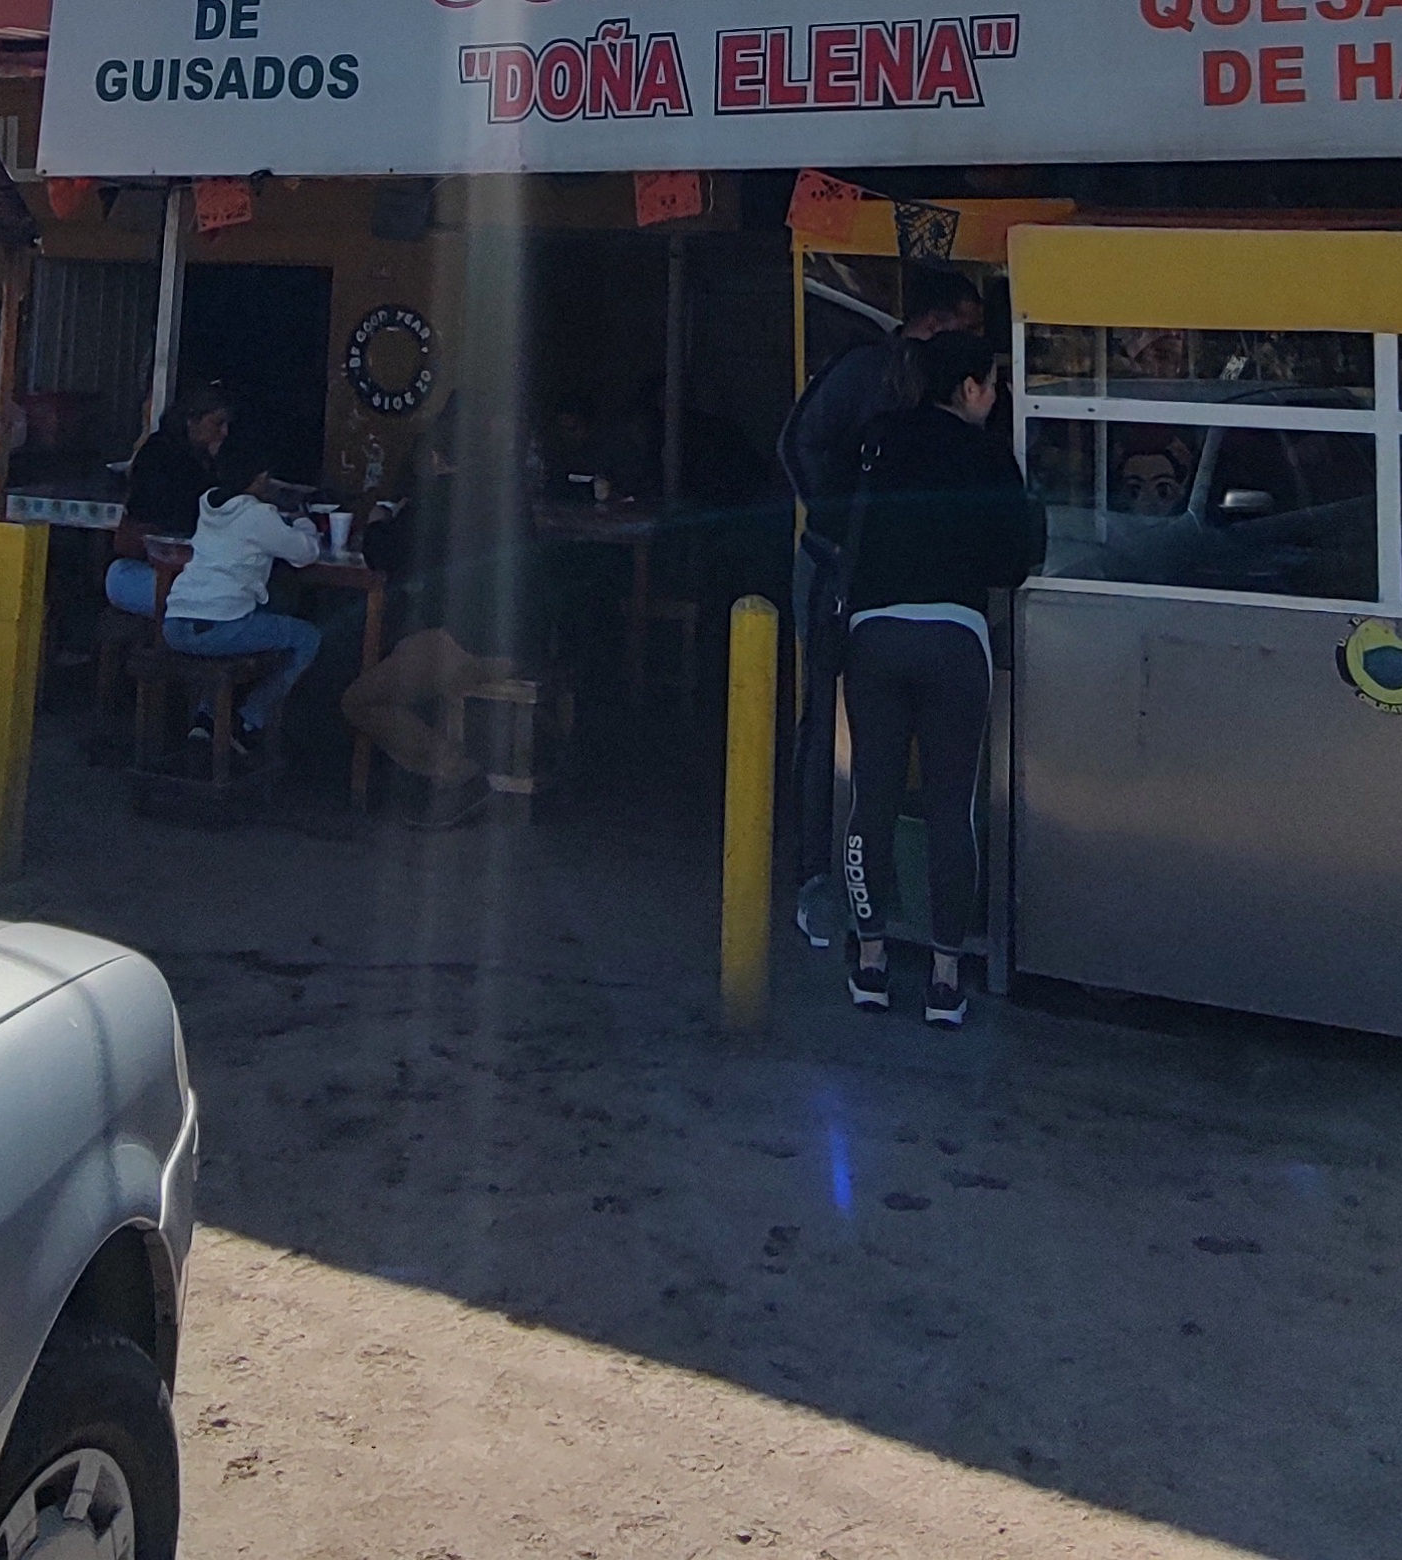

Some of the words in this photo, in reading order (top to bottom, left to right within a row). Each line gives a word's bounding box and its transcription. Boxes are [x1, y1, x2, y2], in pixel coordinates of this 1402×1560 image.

[95, 53, 360, 102] GUISADOS
[460, 18, 693, 125] "DOÑA
[715, 13, 1019, 116] ELENA"
[1203, 46, 1306, 106] DE
[846, 834, 873, 919] adidas
